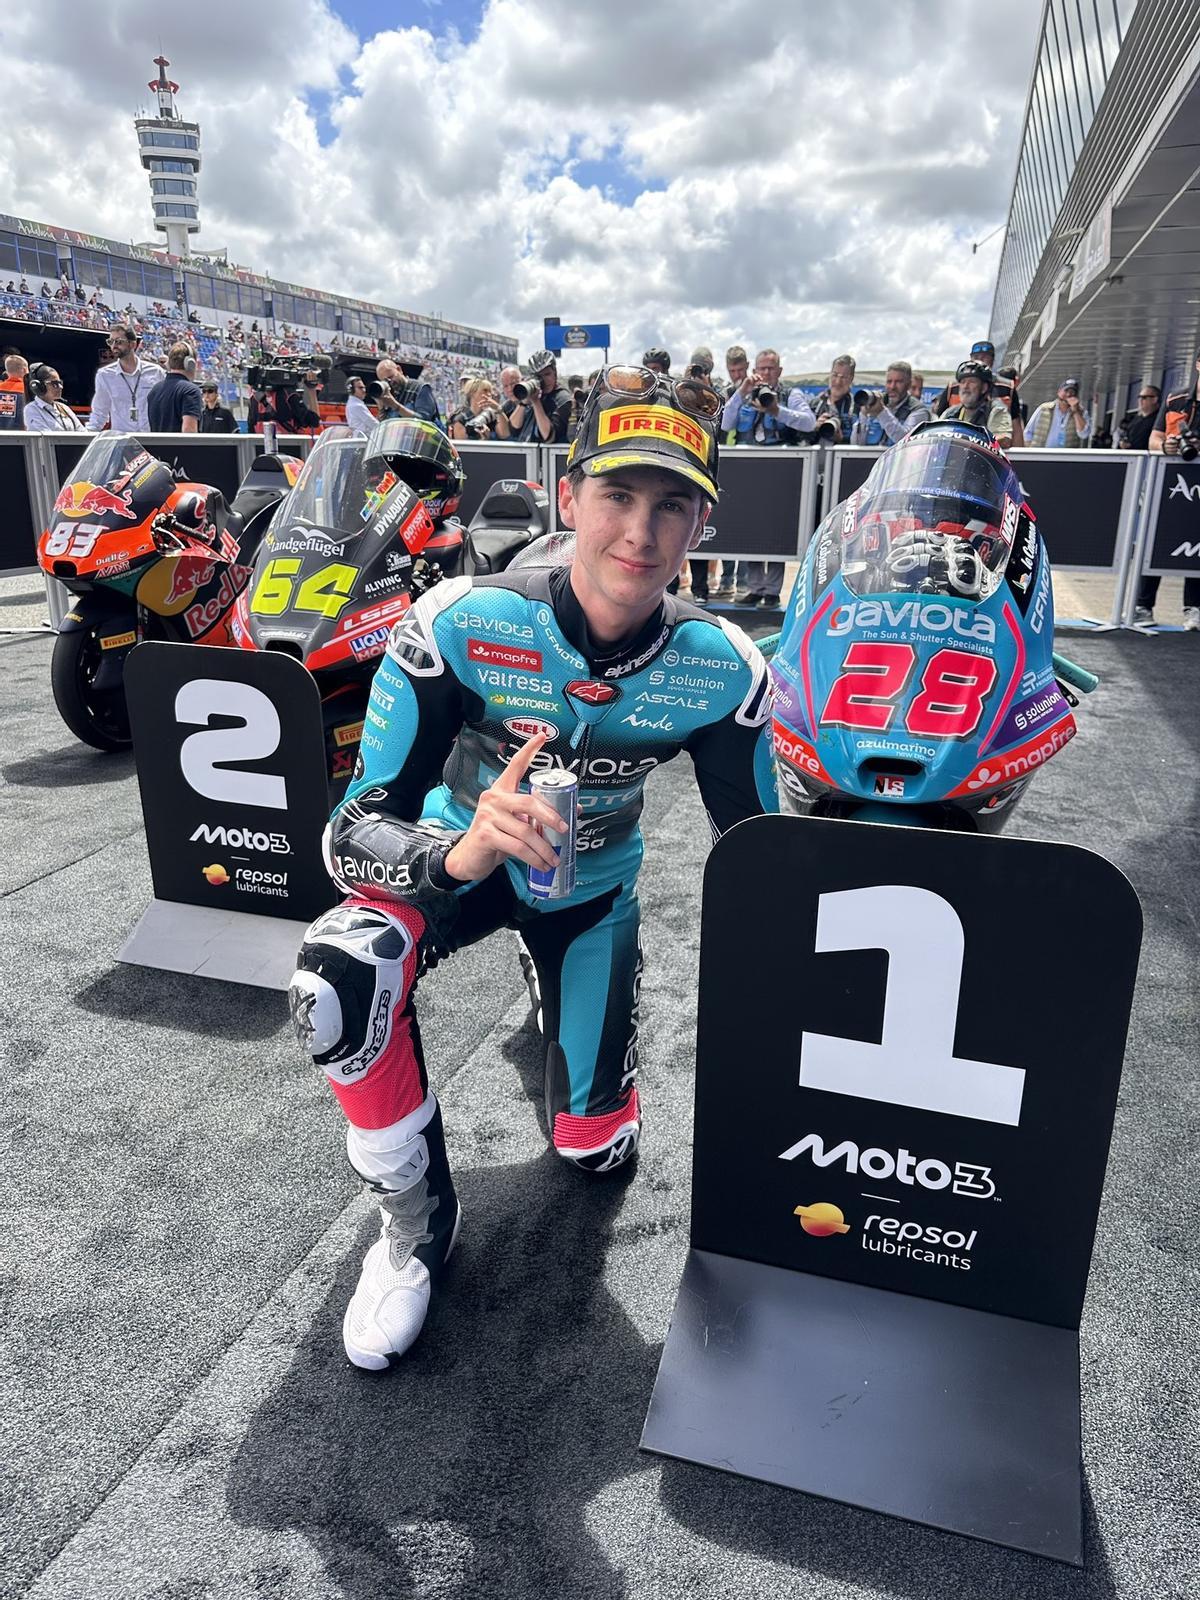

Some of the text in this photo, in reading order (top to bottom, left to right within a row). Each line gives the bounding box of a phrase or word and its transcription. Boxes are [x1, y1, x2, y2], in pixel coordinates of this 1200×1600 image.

[609, 411, 703, 452] PIRELLI
[936, 431, 961, 439] YOU
[373, 486, 411, 536] DYNAVOLT
[45, 522, 111, 557] 83
[271, 537, 345, 557] Landgeflügel
[250, 558, 360, 620] 64
[365, 573, 402, 594] 4LIVING
[184, 571, 235, 638] Red
[344, 600, 402, 632] LS2
[454, 611, 534, 639] gaviota
[826, 601, 996, 644] gaviota
[103, 633, 134, 648] PIRELLI
[352, 626, 391, 653] LIQUI
[545, 627, 584, 670] CFMOTO
[605, 626, 670, 677] alpinestars
[862, 630, 994, 655] The Sun & Shutter Specialists
[491, 650, 538, 666] mapfre
[682, 656, 740, 671] CFMOTO
[477, 668, 554, 695] valresa
[669, 674, 725, 691] solunion
[819, 641, 999, 738] 28
[506, 695, 558, 713] MOTOREX
[635, 691, 708, 711] ASCALE
[1026, 692, 1062, 720] solunion
[511, 721, 550, 738] BELL
[620, 706, 675, 732] inde
[174, 678, 288, 810] 2
[338, 726, 363, 743] PIRE
[856, 740, 936, 756] azulmarino
[774, 732, 820, 773] apfre
[1004, 725, 1075, 778] mapfre
[189, 823, 291, 855] Moto3
[235, 868, 287, 886] repsol
[236, 881, 289, 898] lubricants
[799, 885, 1026, 1127] 1
[342, 989, 391, 1076] alpinestars
[777, 1133, 996, 1200] Moto3
[863, 1213, 978, 1252] repsol
[862, 1238, 972, 1271] lubricants
